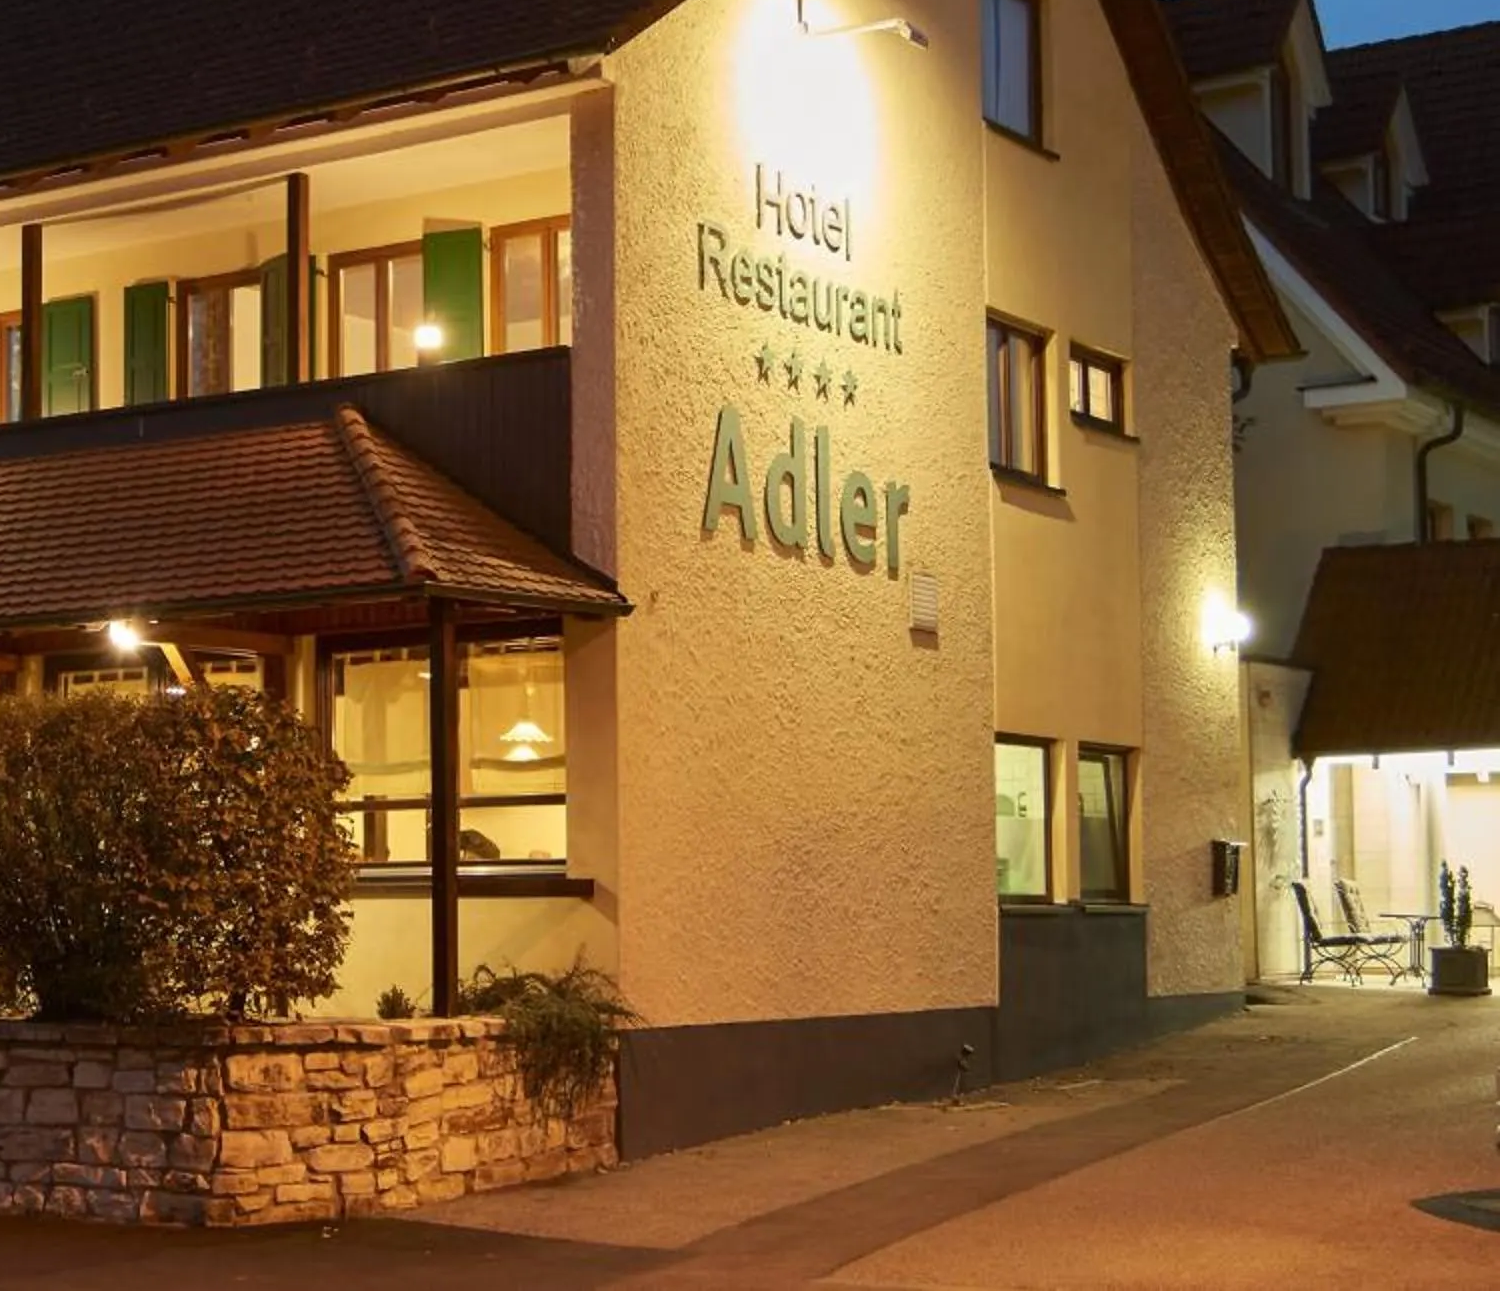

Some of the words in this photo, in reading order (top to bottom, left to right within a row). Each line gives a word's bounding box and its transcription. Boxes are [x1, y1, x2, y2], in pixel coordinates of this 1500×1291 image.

[755, 164, 852, 261] Hotel
[697, 222, 903, 354] Restaurant
[703, 405, 910, 580] Adler
